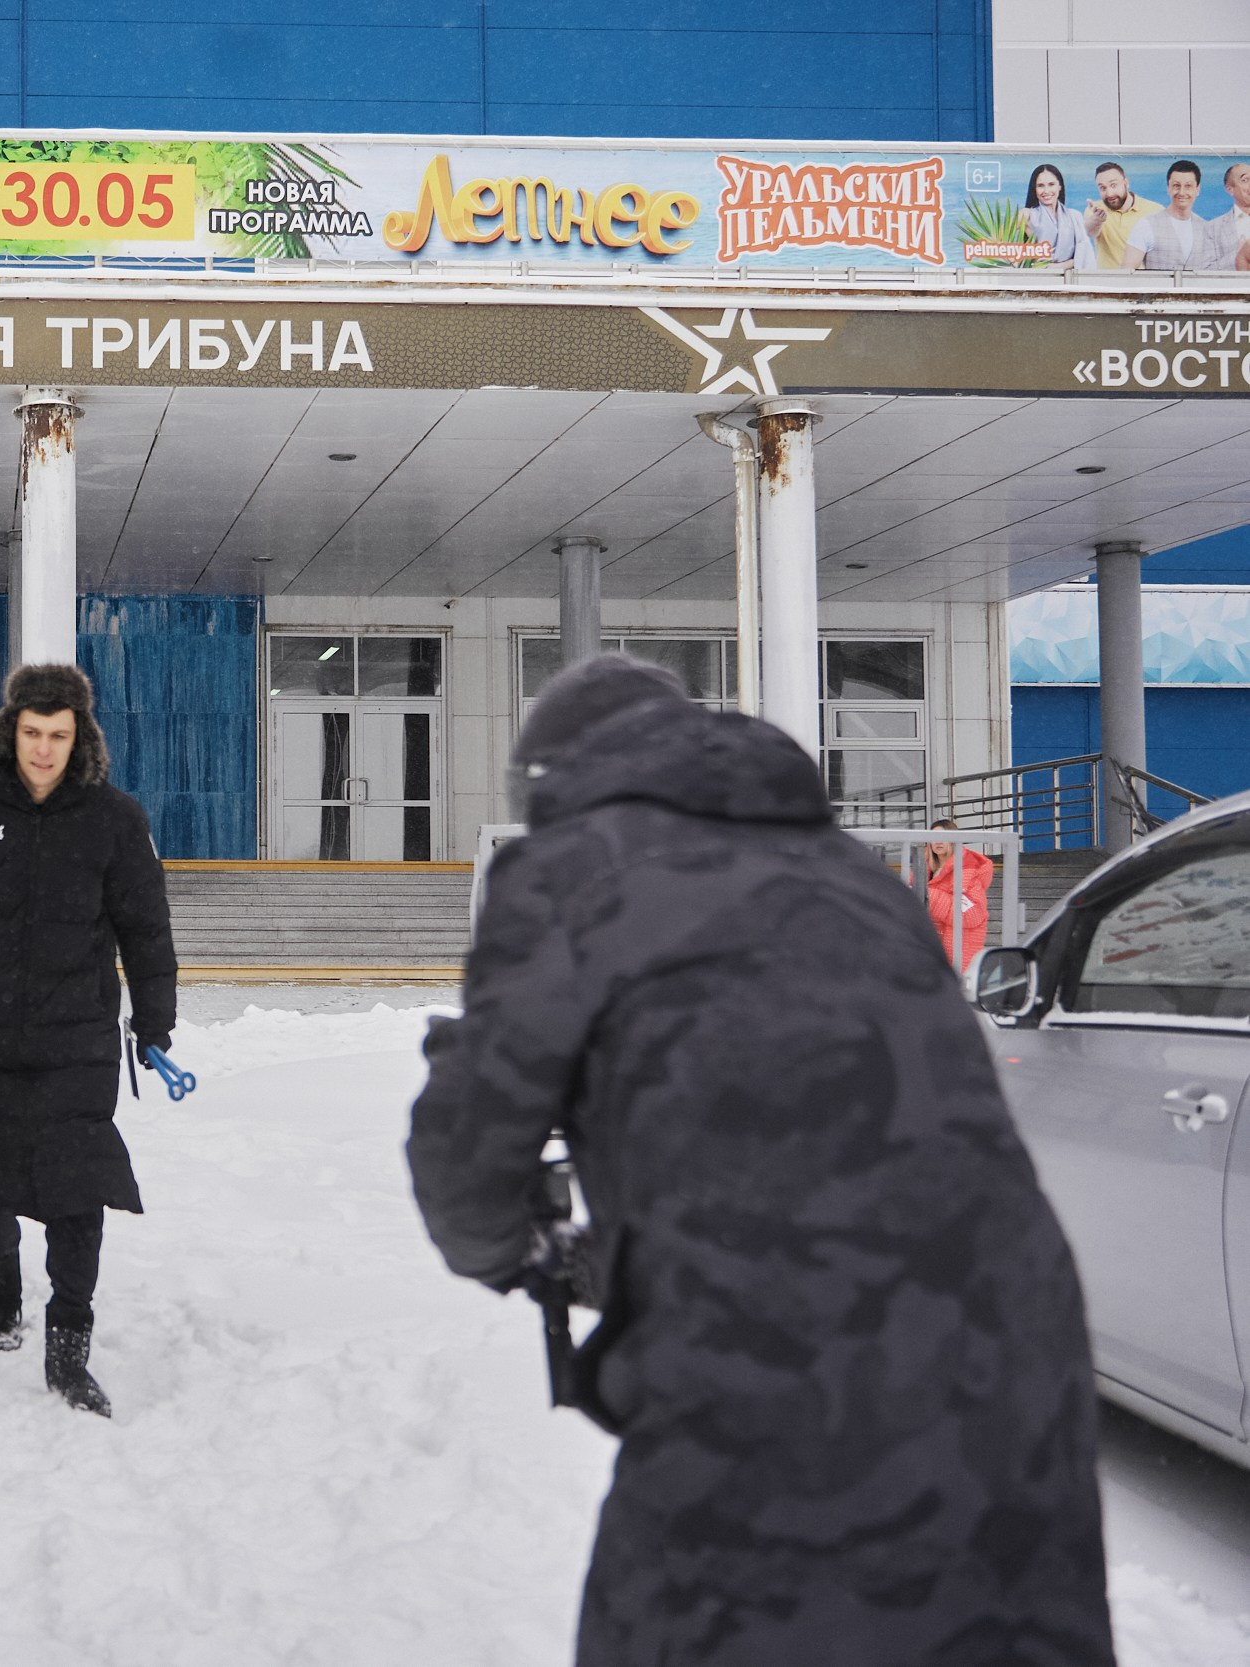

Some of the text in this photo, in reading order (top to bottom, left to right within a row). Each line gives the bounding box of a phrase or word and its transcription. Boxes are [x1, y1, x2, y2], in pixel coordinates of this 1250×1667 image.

[247, 180, 334, 203] НОВАЯ
[722, 160, 939, 208] УРАЛЬСКИЕ
[971, 167, 995, 187] 6+
[2, 171, 174, 228] 30.05
[383, 154, 699, 255] Летнее
[210, 210, 371, 236] ПРОГРАММА
[722, 205, 941, 259] ПЕЛЬМЕНИ
[964, 242, 1050, 261] pelmeny.net
[46, 317, 374, 373] ТРИБУНА
[1072, 348, 1250, 388] «ВОСТ
